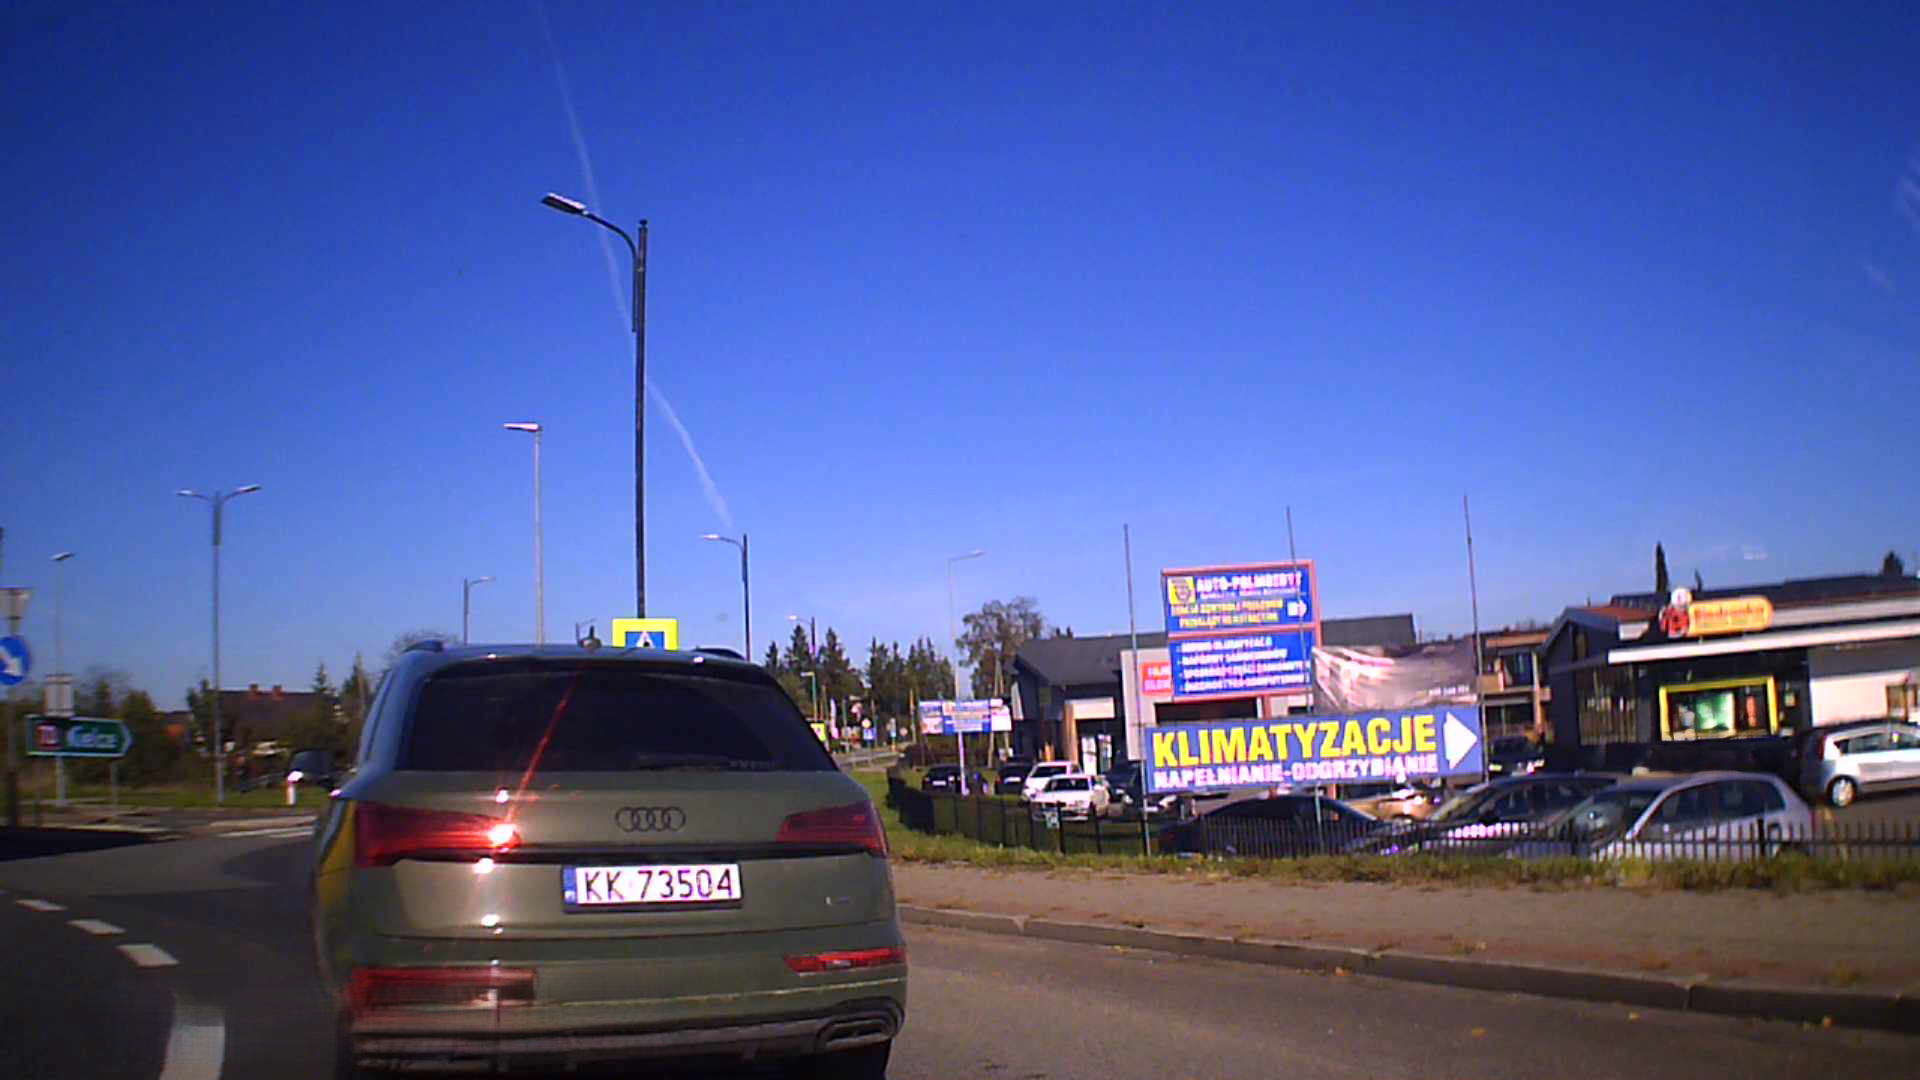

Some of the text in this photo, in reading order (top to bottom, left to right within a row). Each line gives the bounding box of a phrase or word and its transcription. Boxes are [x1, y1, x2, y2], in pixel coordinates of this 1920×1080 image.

[1152, 714, 1437, 768] KLIMATYZACJE
[585, 868, 733, 901] KK 73504
